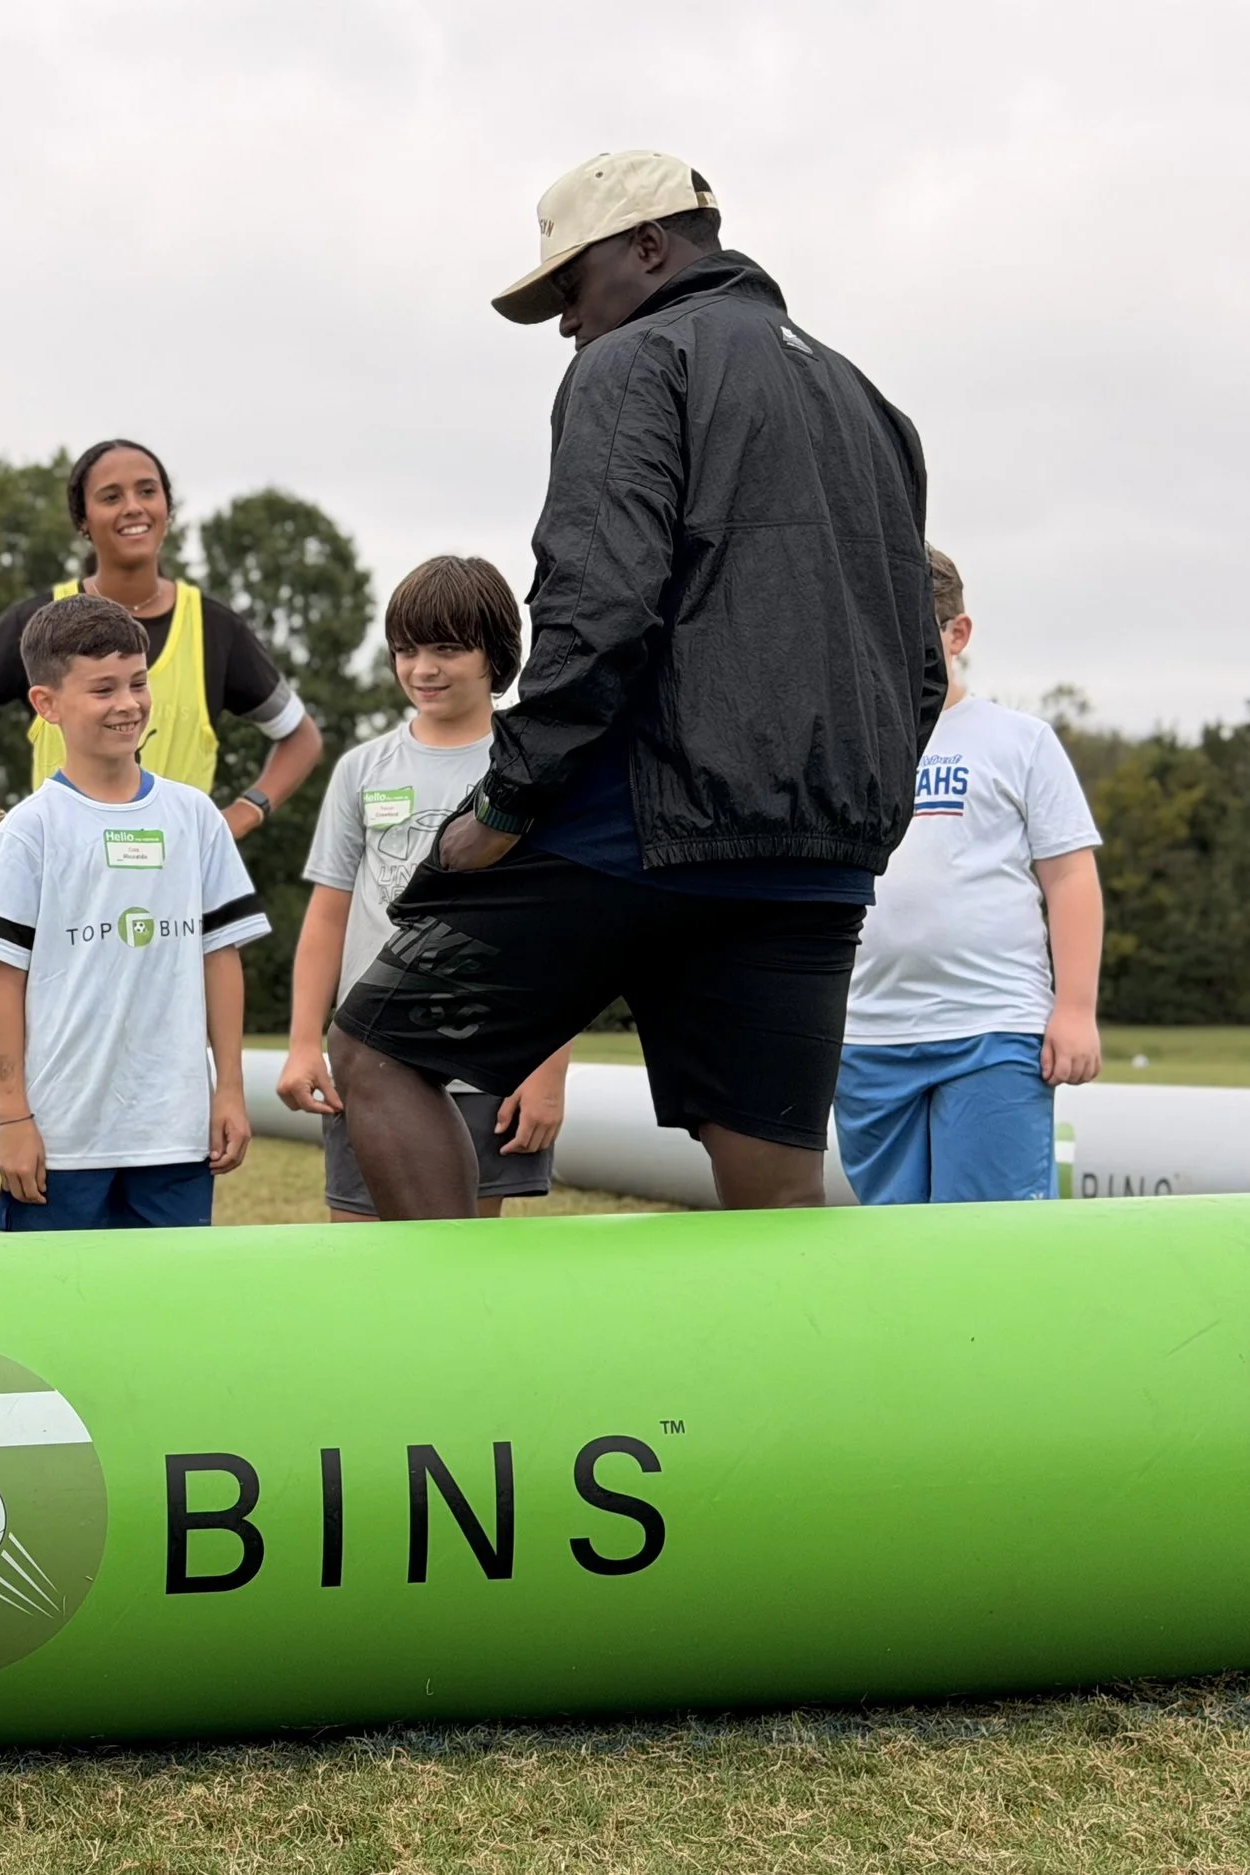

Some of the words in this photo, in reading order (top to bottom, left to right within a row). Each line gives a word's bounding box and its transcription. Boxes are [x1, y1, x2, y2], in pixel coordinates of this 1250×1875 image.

[916, 766, 969, 796] AHS
[105, 831, 135, 842] Hello
[66, 922, 112, 946] TOP
[159, 917, 203, 937] BIN
[164, 1434, 667, 1596] BINS
